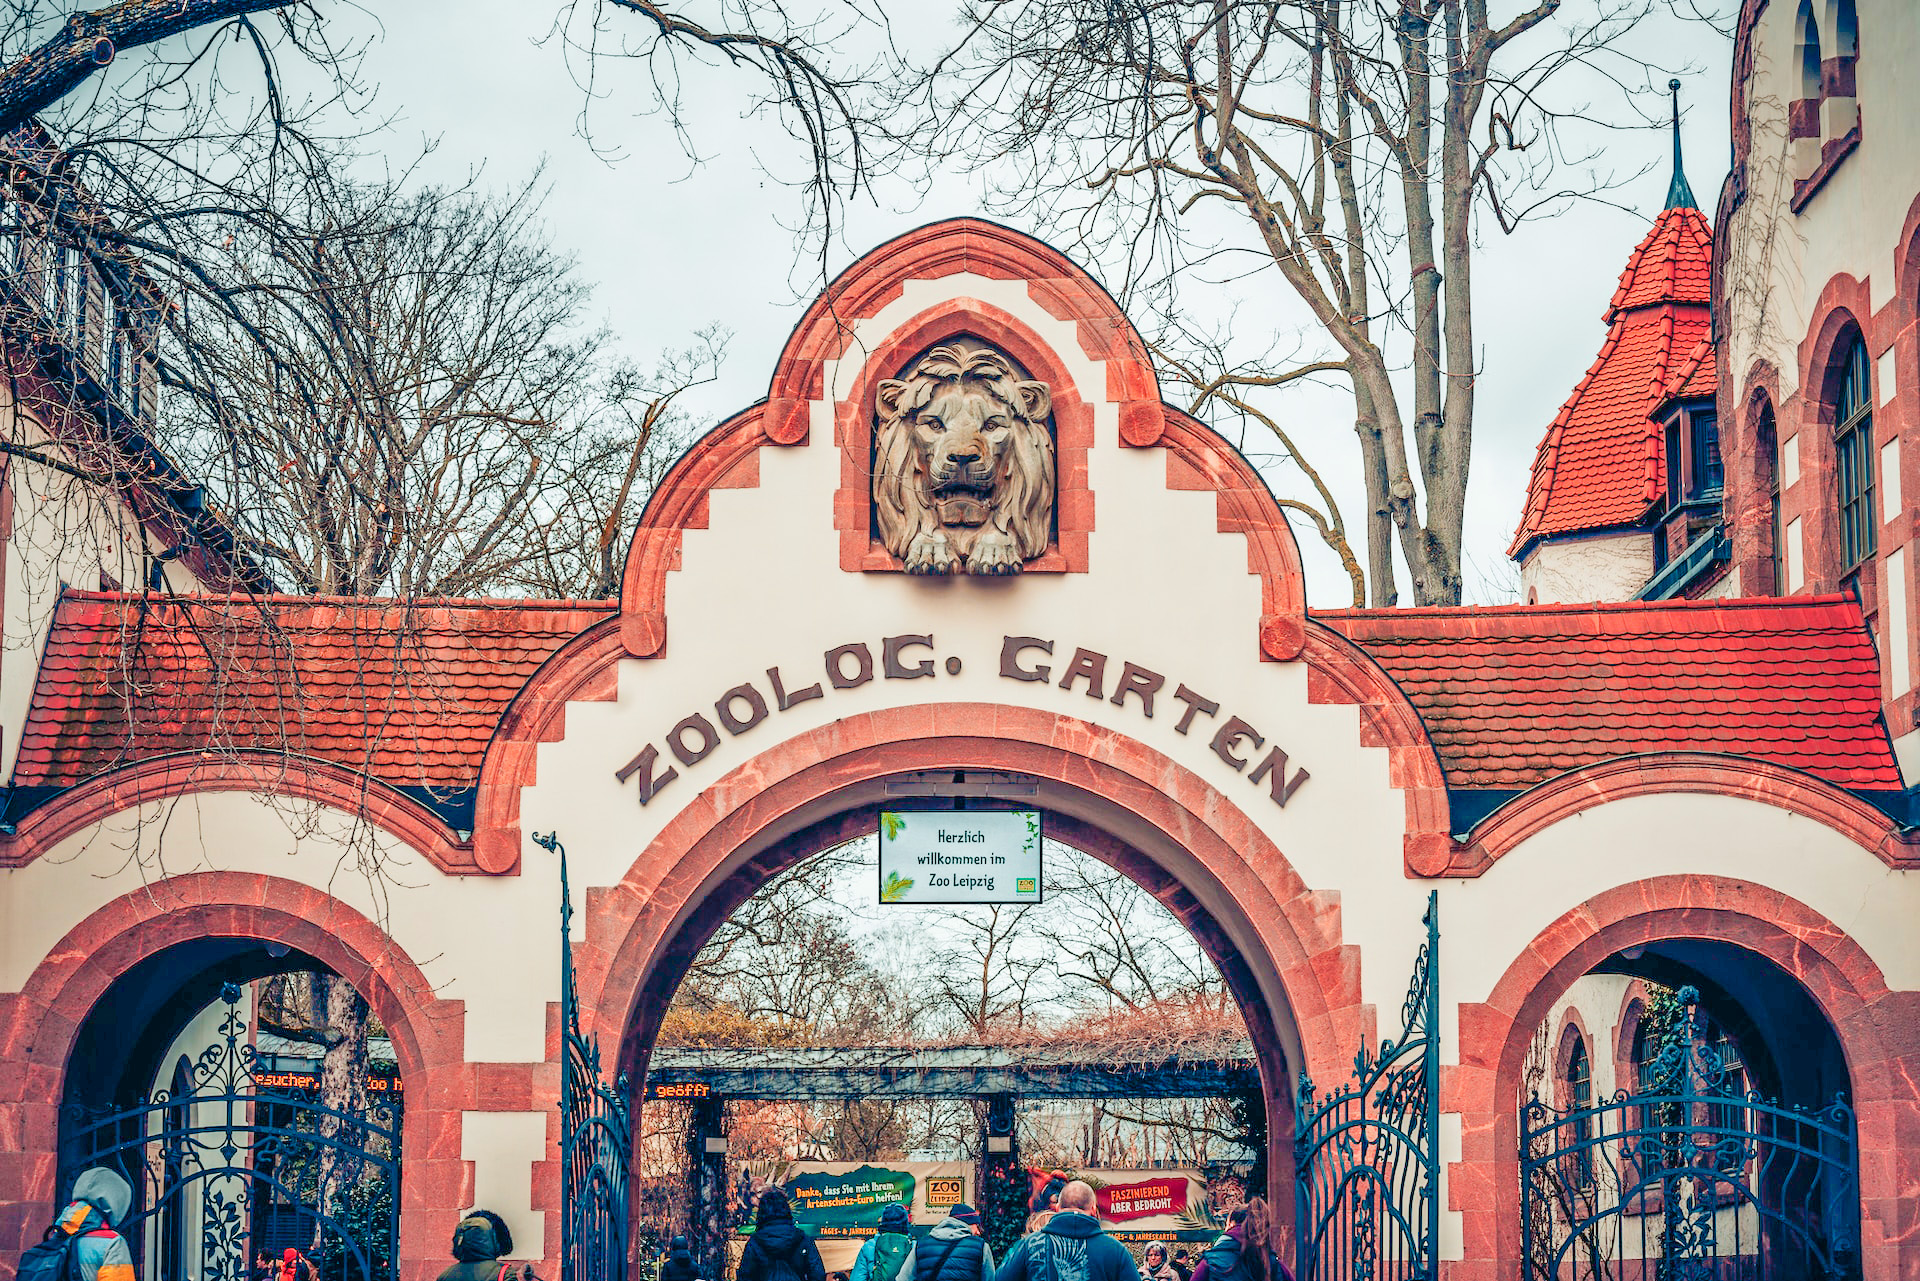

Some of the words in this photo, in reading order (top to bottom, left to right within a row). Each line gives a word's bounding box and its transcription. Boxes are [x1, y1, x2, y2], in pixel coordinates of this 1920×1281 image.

[614, 633, 962, 806] ZOOLOG.
[1000, 636, 1311, 808] GARTEN
[938, 829, 985, 843] Herzlich
[917, 852, 987, 865] willkommen
[990, 852, 1006, 865] im
[928, 873, 950, 887] Zoo
[953, 873, 995, 891] Leipzig
[255, 1072, 321, 1089] esucher,
[795, 1186, 823, 1199] Danke,
[823, 1186, 840, 1196] dass
[841, 1184, 854, 1195] Sie
[855, 1183, 870, 1193] mit
[871, 1182, 895, 1192] Ihrem
[930, 1181, 960, 1193] ZOO
[1110, 1185, 1170, 1201] FASZINIEREND
[806, 1194, 875, 1209] Artenschutz-Euro
[875, 1190, 903, 1203] helfen!
[1110, 1201, 1132, 1214] ABER
[1133, 1198, 1172, 1211] BEDROHT
[820, 1227, 842, 1235] TAGES-
[842, 1227, 848, 1235] &
[848, 1227, 879, 1236] JAHRESKA
[1128, 1233, 1135, 1241] &
[1135, 1232, 1178, 1241] JAHRESKARTEN
